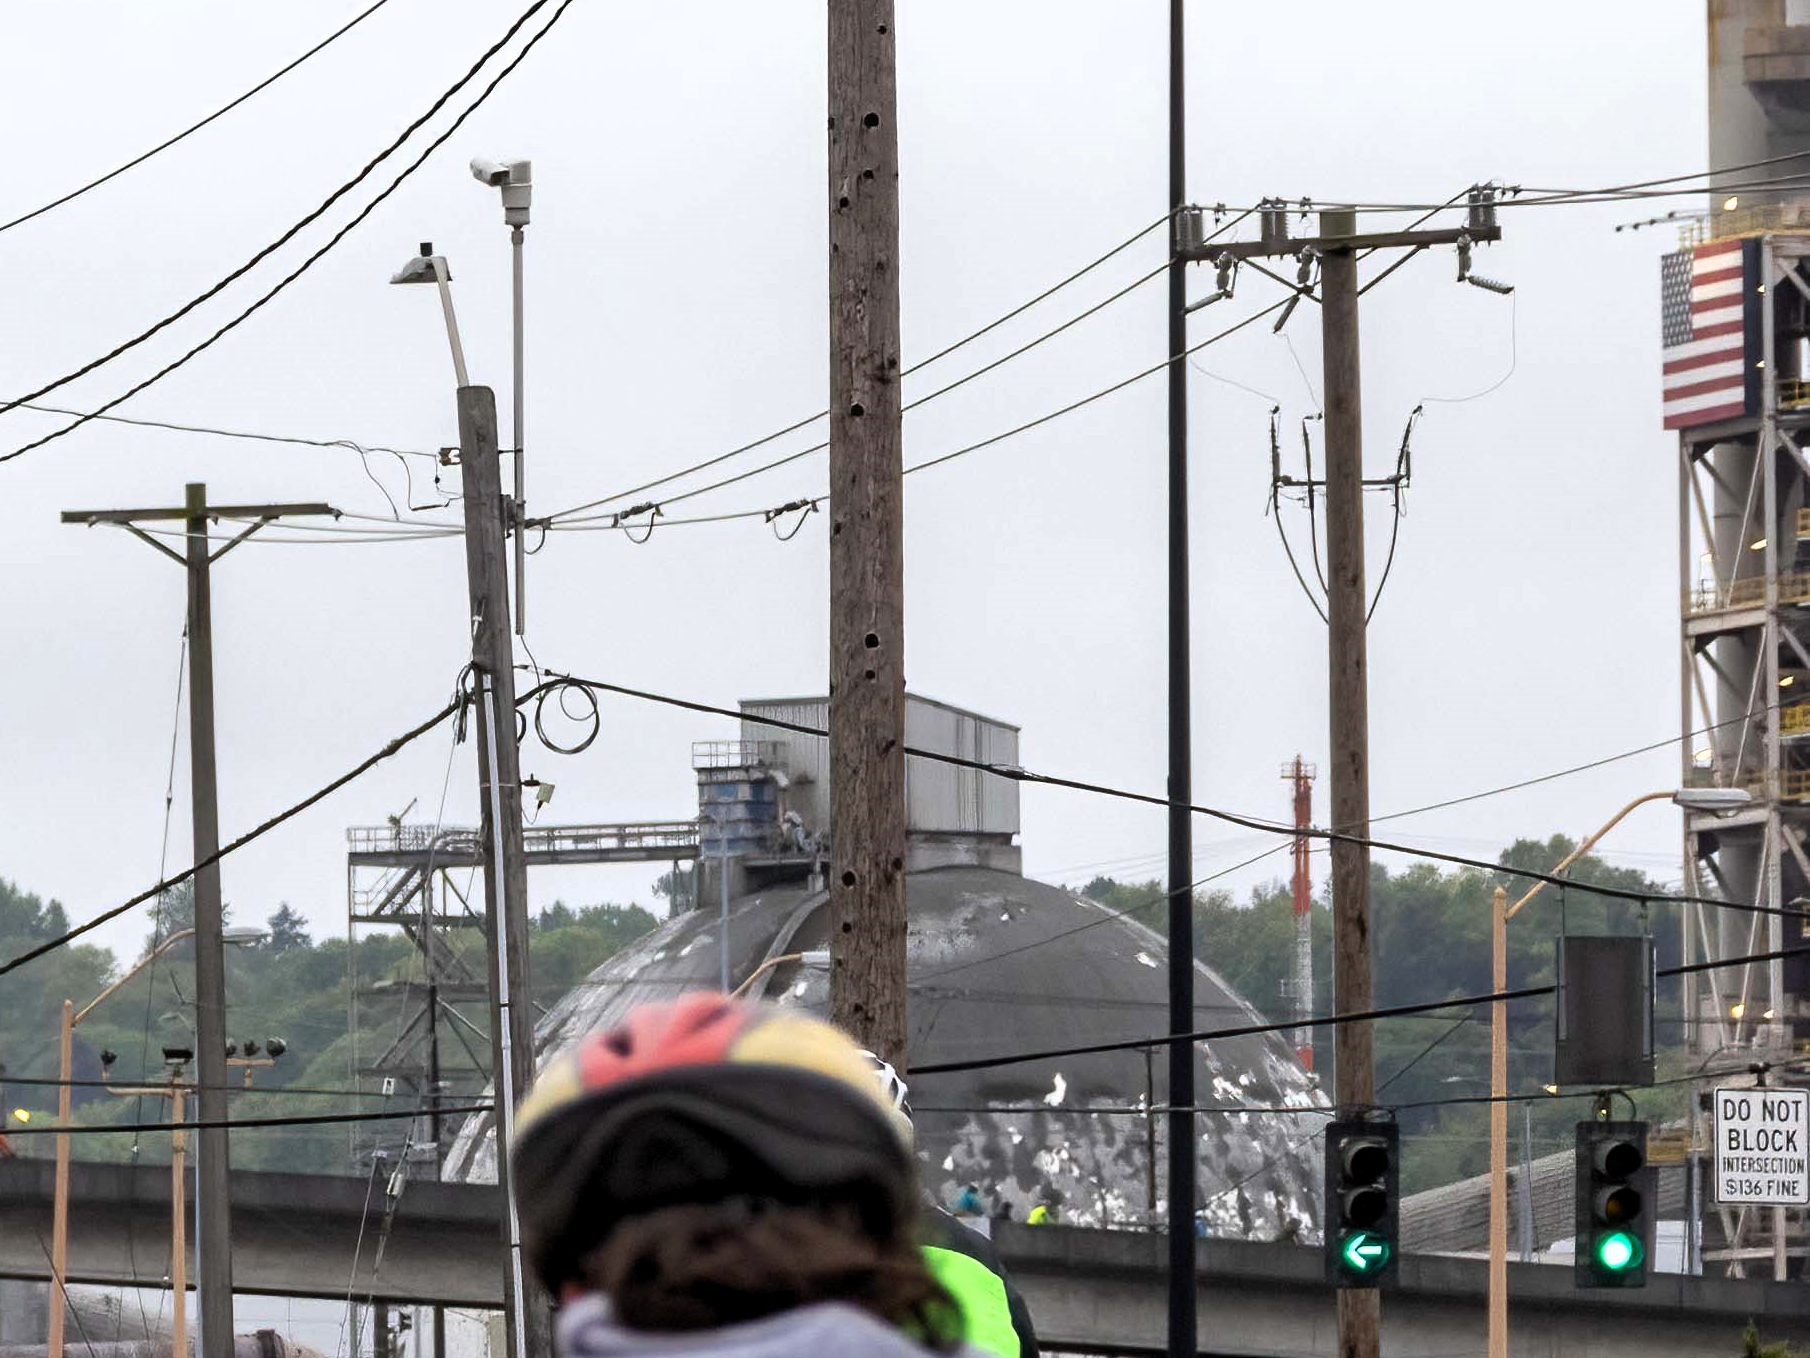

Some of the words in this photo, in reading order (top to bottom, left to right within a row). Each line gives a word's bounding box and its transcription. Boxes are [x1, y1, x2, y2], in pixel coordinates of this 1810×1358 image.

[1723, 1098, 1751, 1122] DO
[1762, 1098, 1802, 1122] NOT
[1728, 1128, 1798, 1153] BLOCK
[1722, 1156, 1805, 1174] INTERSECTION
[1726, 1178, 1763, 1196] $136
[1767, 1179, 1800, 1197] FINE
